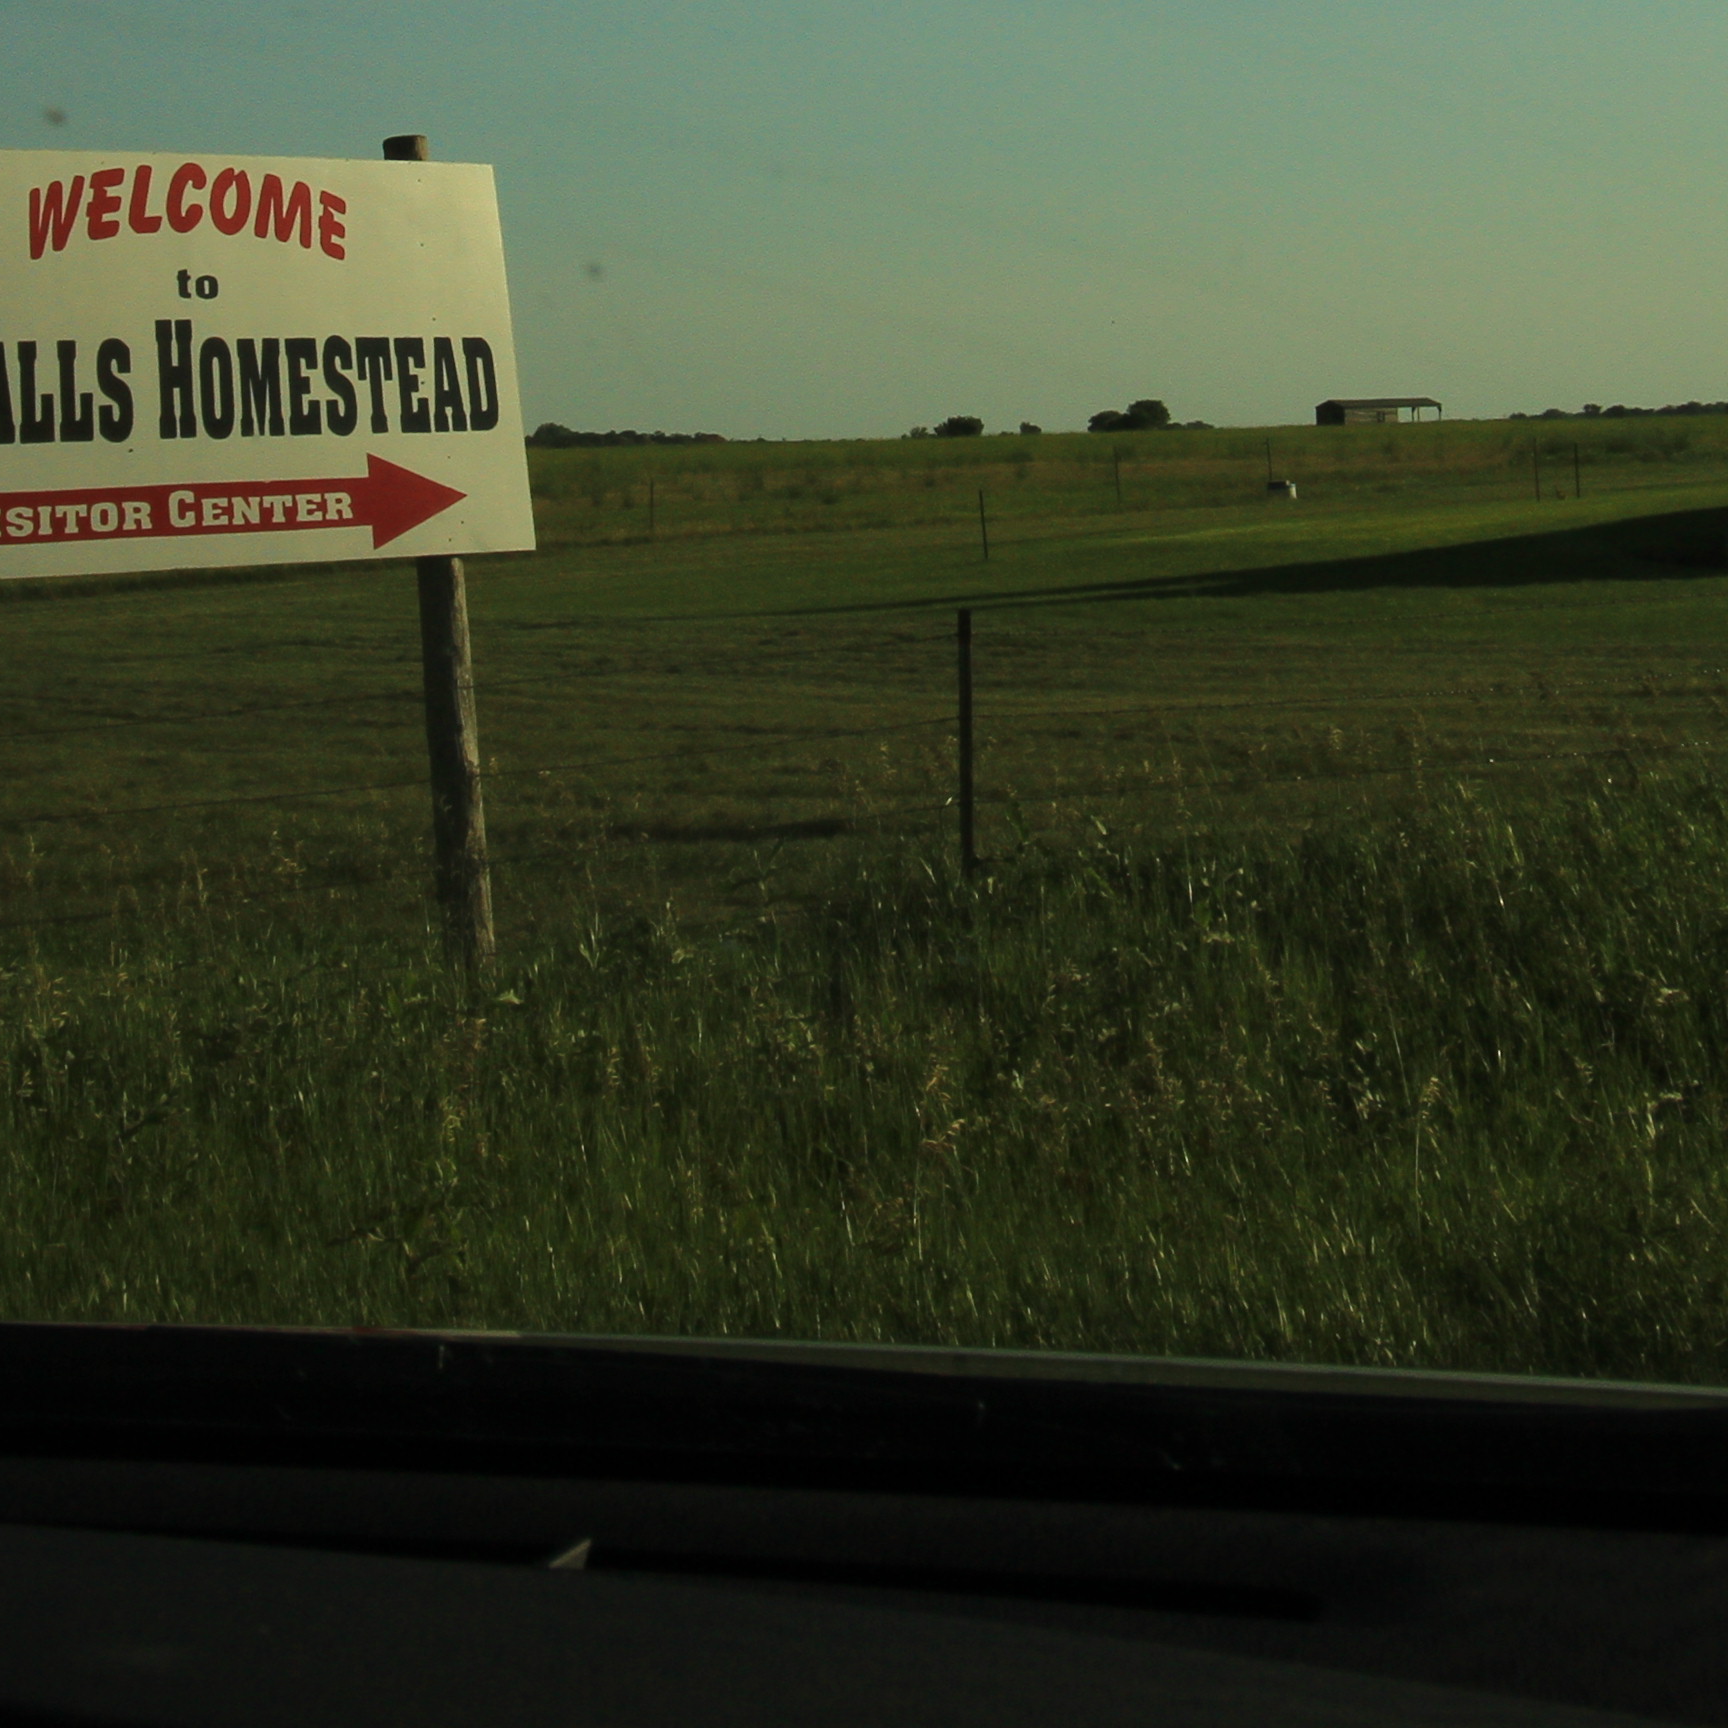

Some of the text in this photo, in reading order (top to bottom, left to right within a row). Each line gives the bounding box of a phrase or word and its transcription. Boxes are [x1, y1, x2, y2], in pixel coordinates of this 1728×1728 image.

[30, 163, 346, 260] WELCOME
[177, 269, 219, 299] to
[155, 319, 500, 439] HOMESTEAD
[168, 489, 354, 528] CENTER
